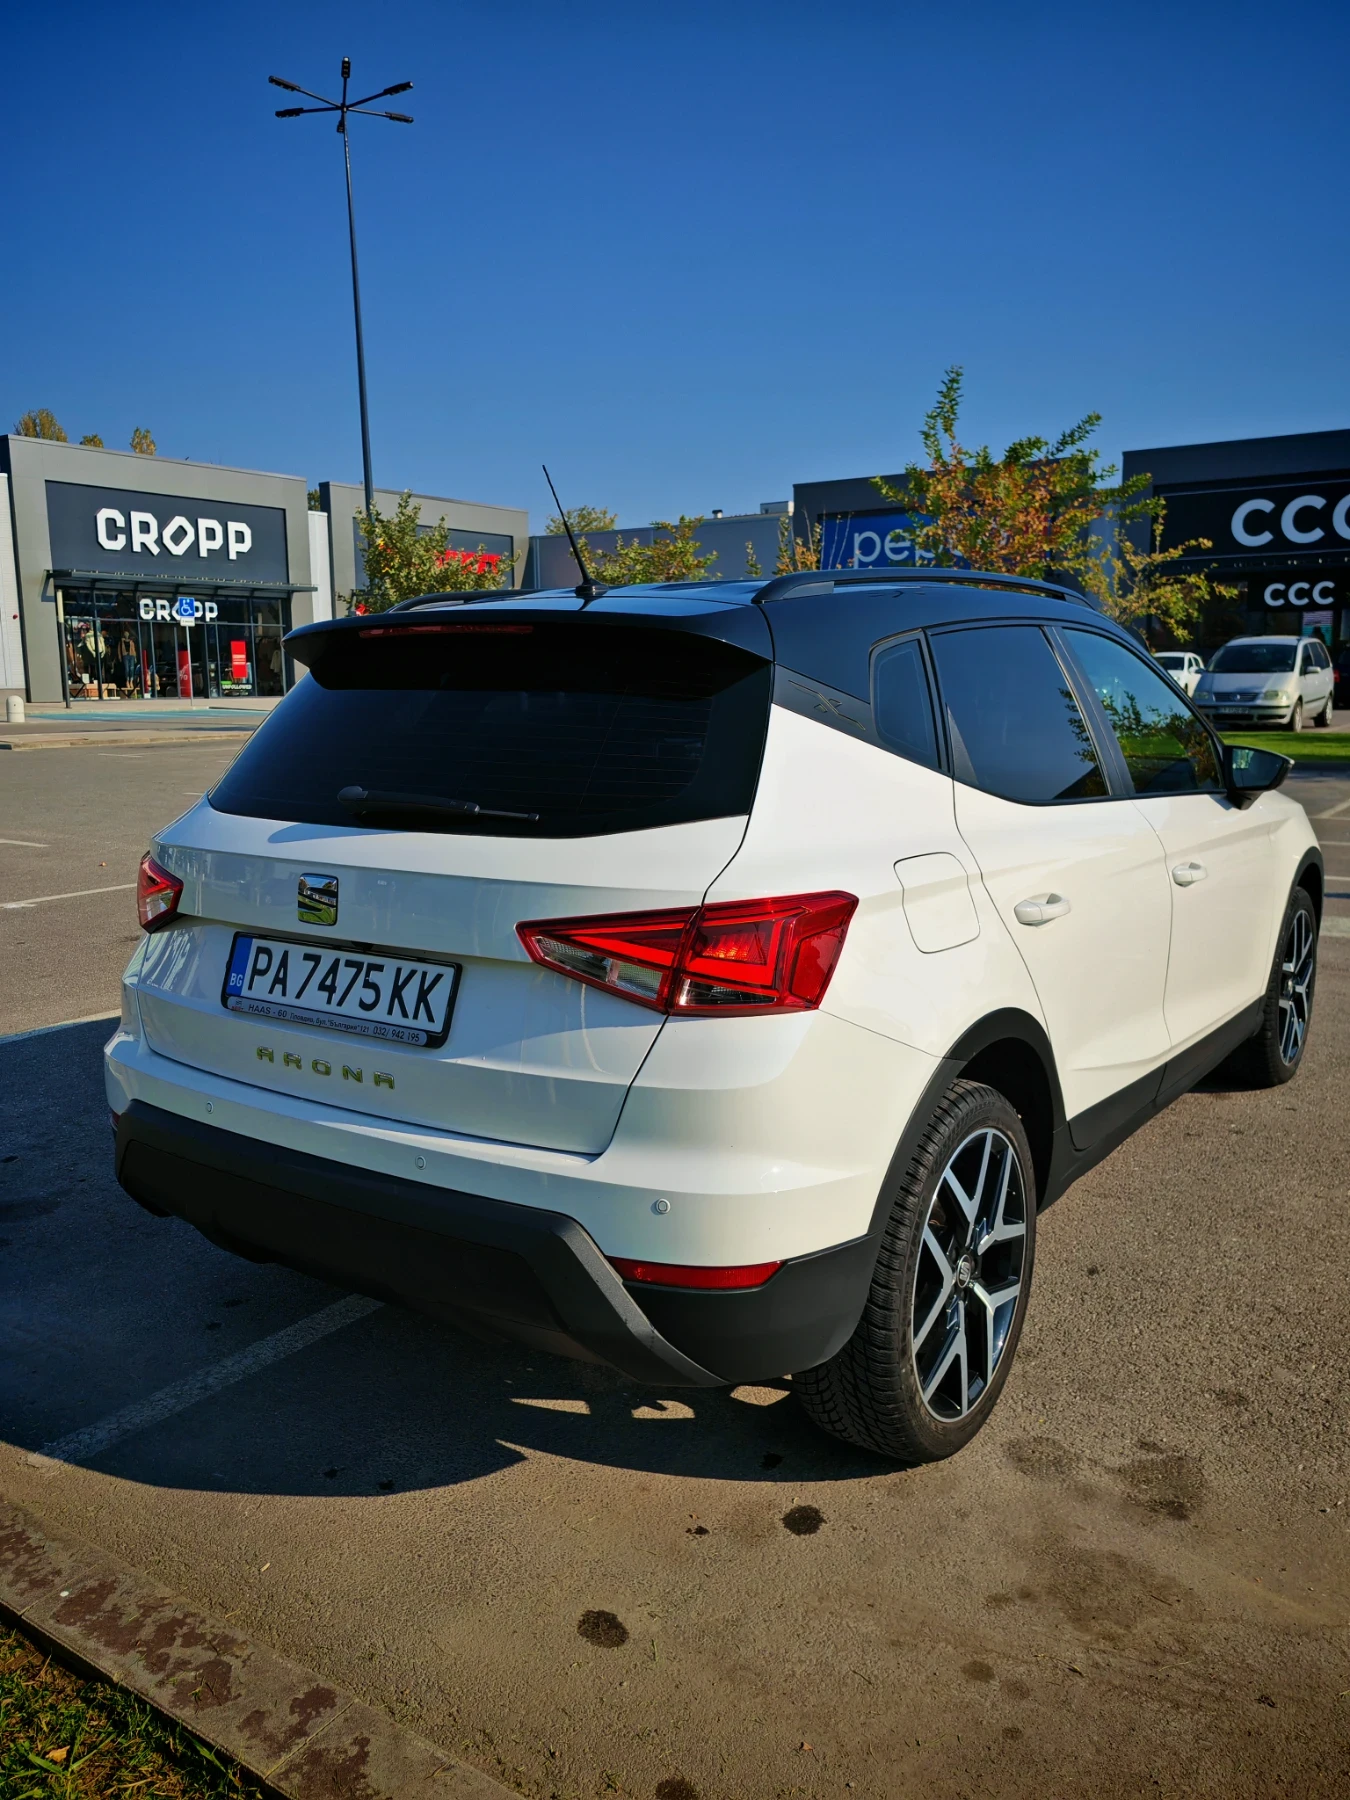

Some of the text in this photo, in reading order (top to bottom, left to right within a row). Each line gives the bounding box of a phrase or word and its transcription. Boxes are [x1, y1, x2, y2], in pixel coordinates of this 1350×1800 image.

[96, 508, 252, 560] CROPP
[1264, 581, 1335, 606] CCC
[230, 973, 243, 987] BG
[248, 1004, 271, 1015] HAAS
[277, 1009, 287, 1018] 60
[391, 1029, 404, 1039] 942
[407, 1032, 419, 1042] 195
[256, 1046, 395, 1089] ARONA
